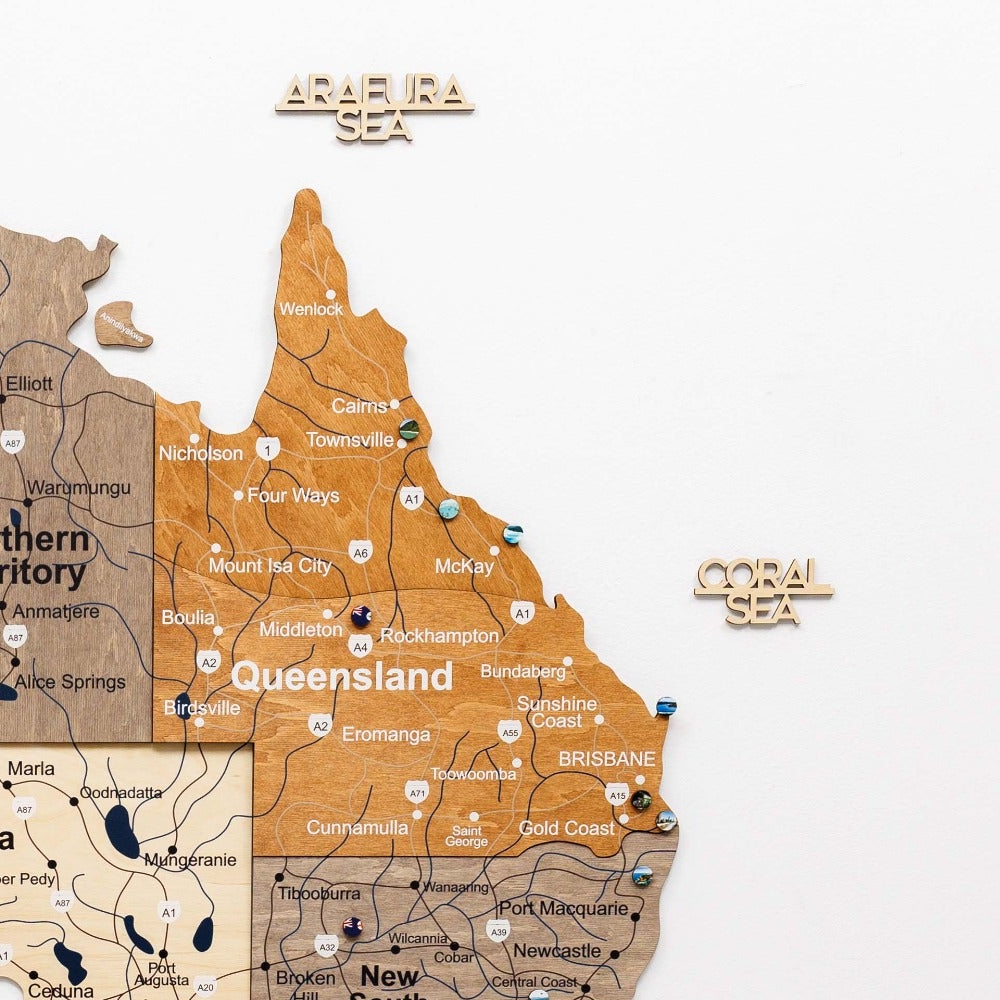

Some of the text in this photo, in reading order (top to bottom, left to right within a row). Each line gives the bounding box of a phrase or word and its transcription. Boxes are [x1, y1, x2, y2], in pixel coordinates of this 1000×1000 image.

[279, 73, 471, 108] ARAFURA
[336, 108, 412, 141] SEA
[280, 302, 343, 315] Wenlock
[6, 376, 52, 391] Elliott
[332, 399, 387, 413] Cairns
[6, 439, 20, 448] A87
[306, 432, 394, 448] Townsville
[159, 446, 243, 461] Nicholson
[28, 481, 130, 498] Warumungu
[248, 488, 339, 506] Four Ways
[209, 558, 332, 576] Mount Isa City
[436, 558, 494, 576] McKay
[698, 557, 831, 592] CORAL
[13, 605, 99, 622] Anmatjere
[726, 592, 800, 625] SEA
[162, 611, 215, 625] Boulia
[260, 623, 342, 637] Middleton
[382, 628, 499, 646] Rockhampton
[8, 634, 23, 642] A87
[203, 658, 216, 668] A2
[231, 660, 453, 691] Queensland
[481, 665, 566, 681] Bundaberg
[15, 674, 126, 693] Alice Springs
[165, 701, 240, 715] Birdsville
[518, 697, 597, 711] Sunshine
[532, 714, 582, 728] Coast
[343, 727, 430, 744] Eromanga
[559, 752, 655, 767] BRISBANE
[8, 762, 54, 776] Marla
[431, 768, 516, 780] Toowoomba
[80, 787, 162, 799] Oodnadatta
[307, 821, 408, 835] Cunnamulla
[452, 825, 481, 836] Saint
[519, 821, 615, 835] Gold Coast
[446, 836, 488, 848] George
[145, 854, 236, 870] Mungeranie
[20, 873, 55, 889] Pedy
[423, 882, 488, 894] Wanaaring
[278, 887, 360, 900] Tibooburra
[163, 908, 176, 918] A1
[500, 901, 628, 919] Port Macquarie
[389, 933, 447, 943] Wilcannia
[434, 952, 474, 963] Cobar
[514, 943, 601, 958] Newcastle
[149, 963, 175, 973] Port
[135, 975, 188, 988] Augusta
[277, 972, 335, 985] Broken
[362, 965, 419, 986] New
[493, 977, 577, 988] Central Coast
[28, 985, 94, 998] Ceduna
[198, 983, 213, 991] A20
